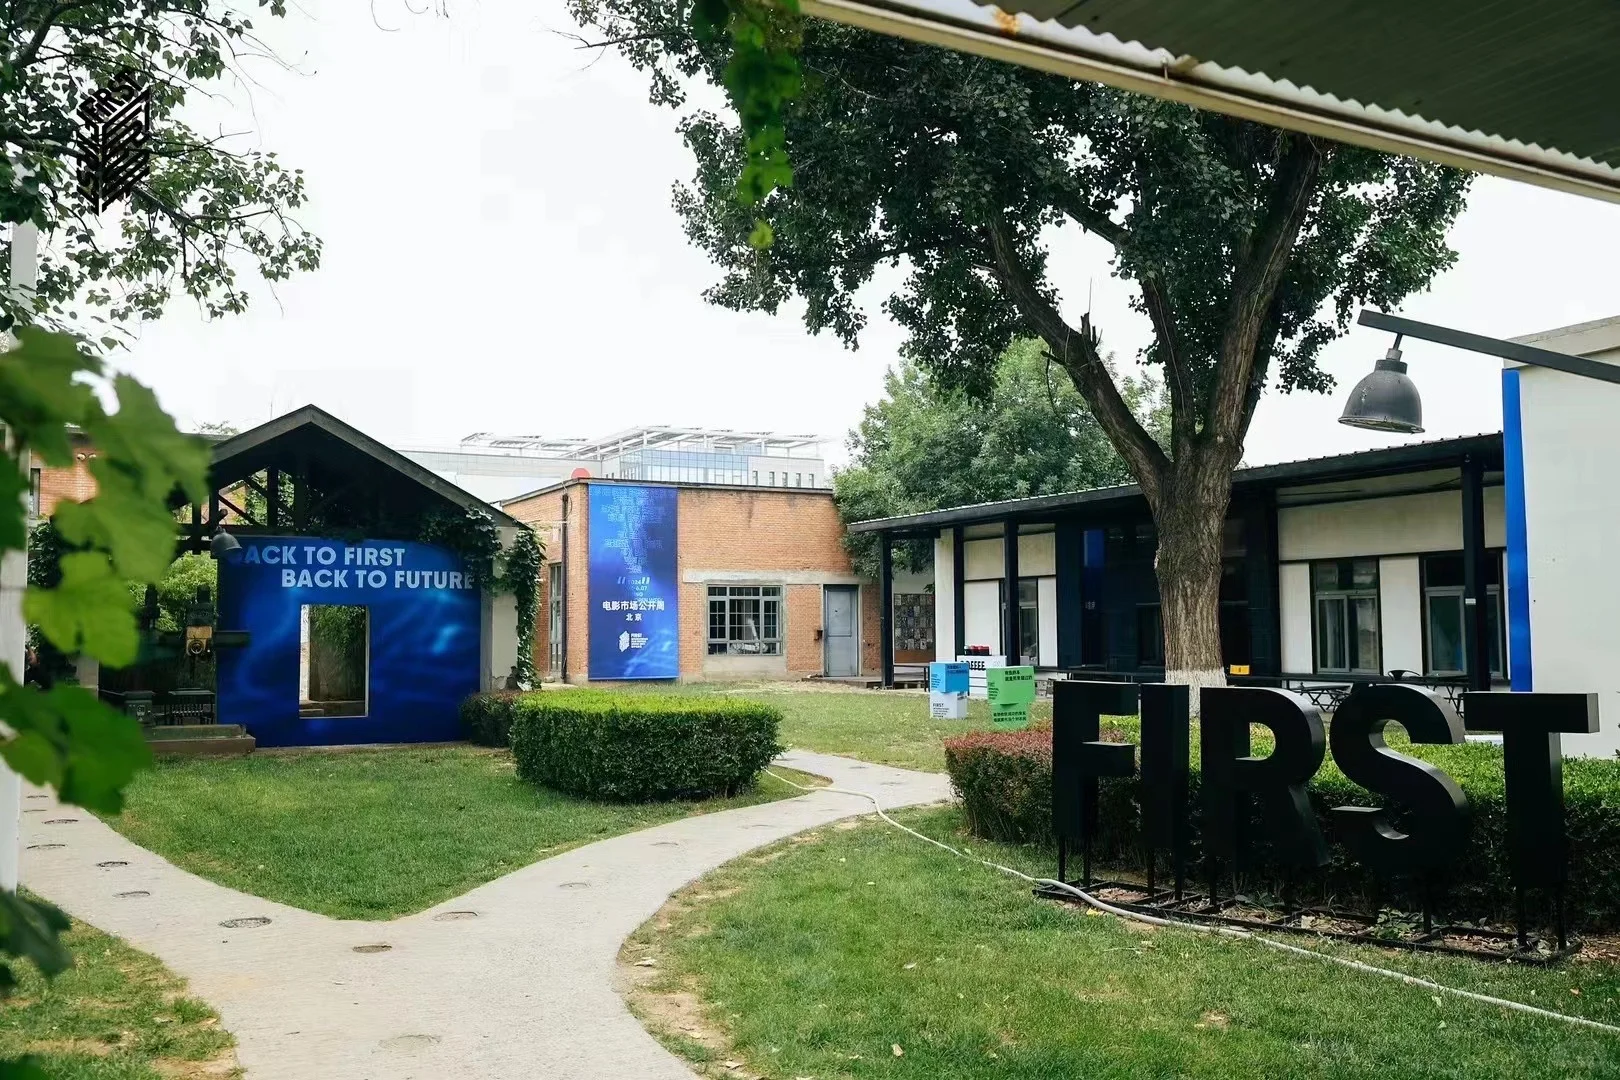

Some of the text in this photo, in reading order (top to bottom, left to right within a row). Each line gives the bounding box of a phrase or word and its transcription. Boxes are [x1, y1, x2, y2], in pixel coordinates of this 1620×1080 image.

[244, 546, 406, 566] ACK TO FIRST
[281, 569, 349, 588] BACK
[355, 570, 388, 588] TO
[602, 600, 665, 611] 电影市场公开周
[625, 613, 642, 621] 北京
[959, 660, 987, 671] FFEE
[1052, 680, 1601, 889] FIRST
